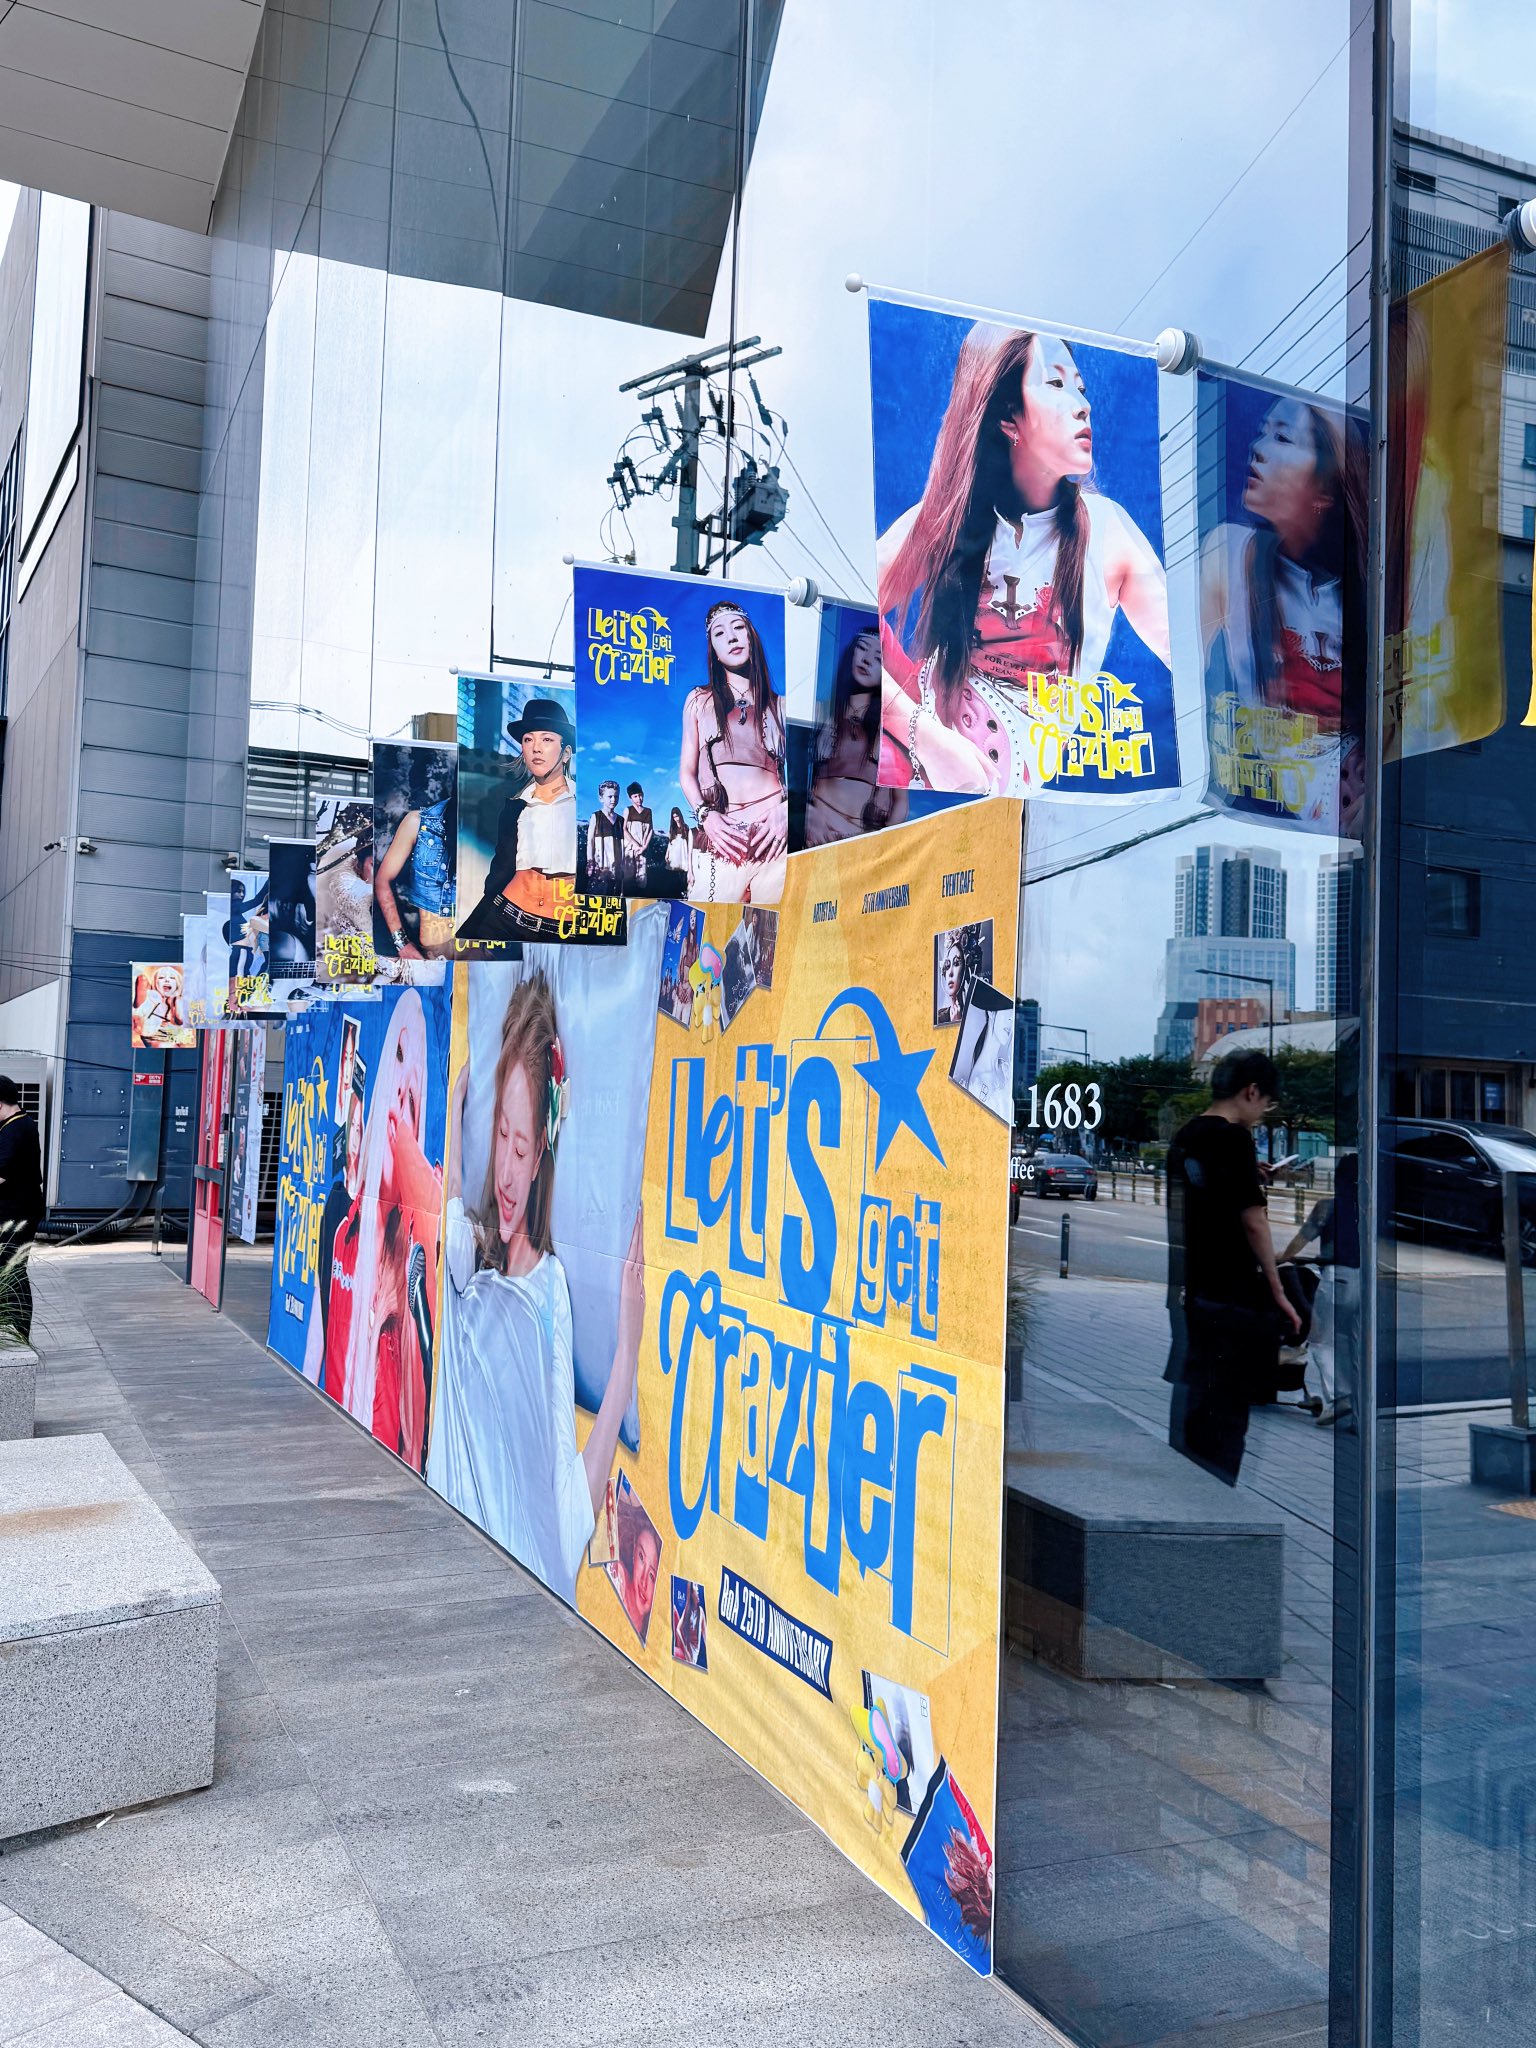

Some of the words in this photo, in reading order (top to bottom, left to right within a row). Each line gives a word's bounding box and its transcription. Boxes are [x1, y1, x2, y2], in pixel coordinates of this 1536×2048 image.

[588, 642, 676, 686] Crazier
[652, 633, 672, 653] get
[1029, 722, 1155, 784] Crazier
[941, 872, 959, 898] EVENT
[959, 869, 975, 894] CAFE
[554, 905, 623, 939] Crazier
[1028, 1082, 1102, 1130] 1683
[1010, 1156, 1035, 1180] ffee
[277, 1174, 327, 1288] Crazier
[852, 1192, 941, 1340] get
[659, 1268, 958, 1657] Crazier
[720, 1573, 740, 1626] BoA
[740, 1586, 767, 1645] 25TH
[766, 1604, 830, 1692] ANNIVERSARY
